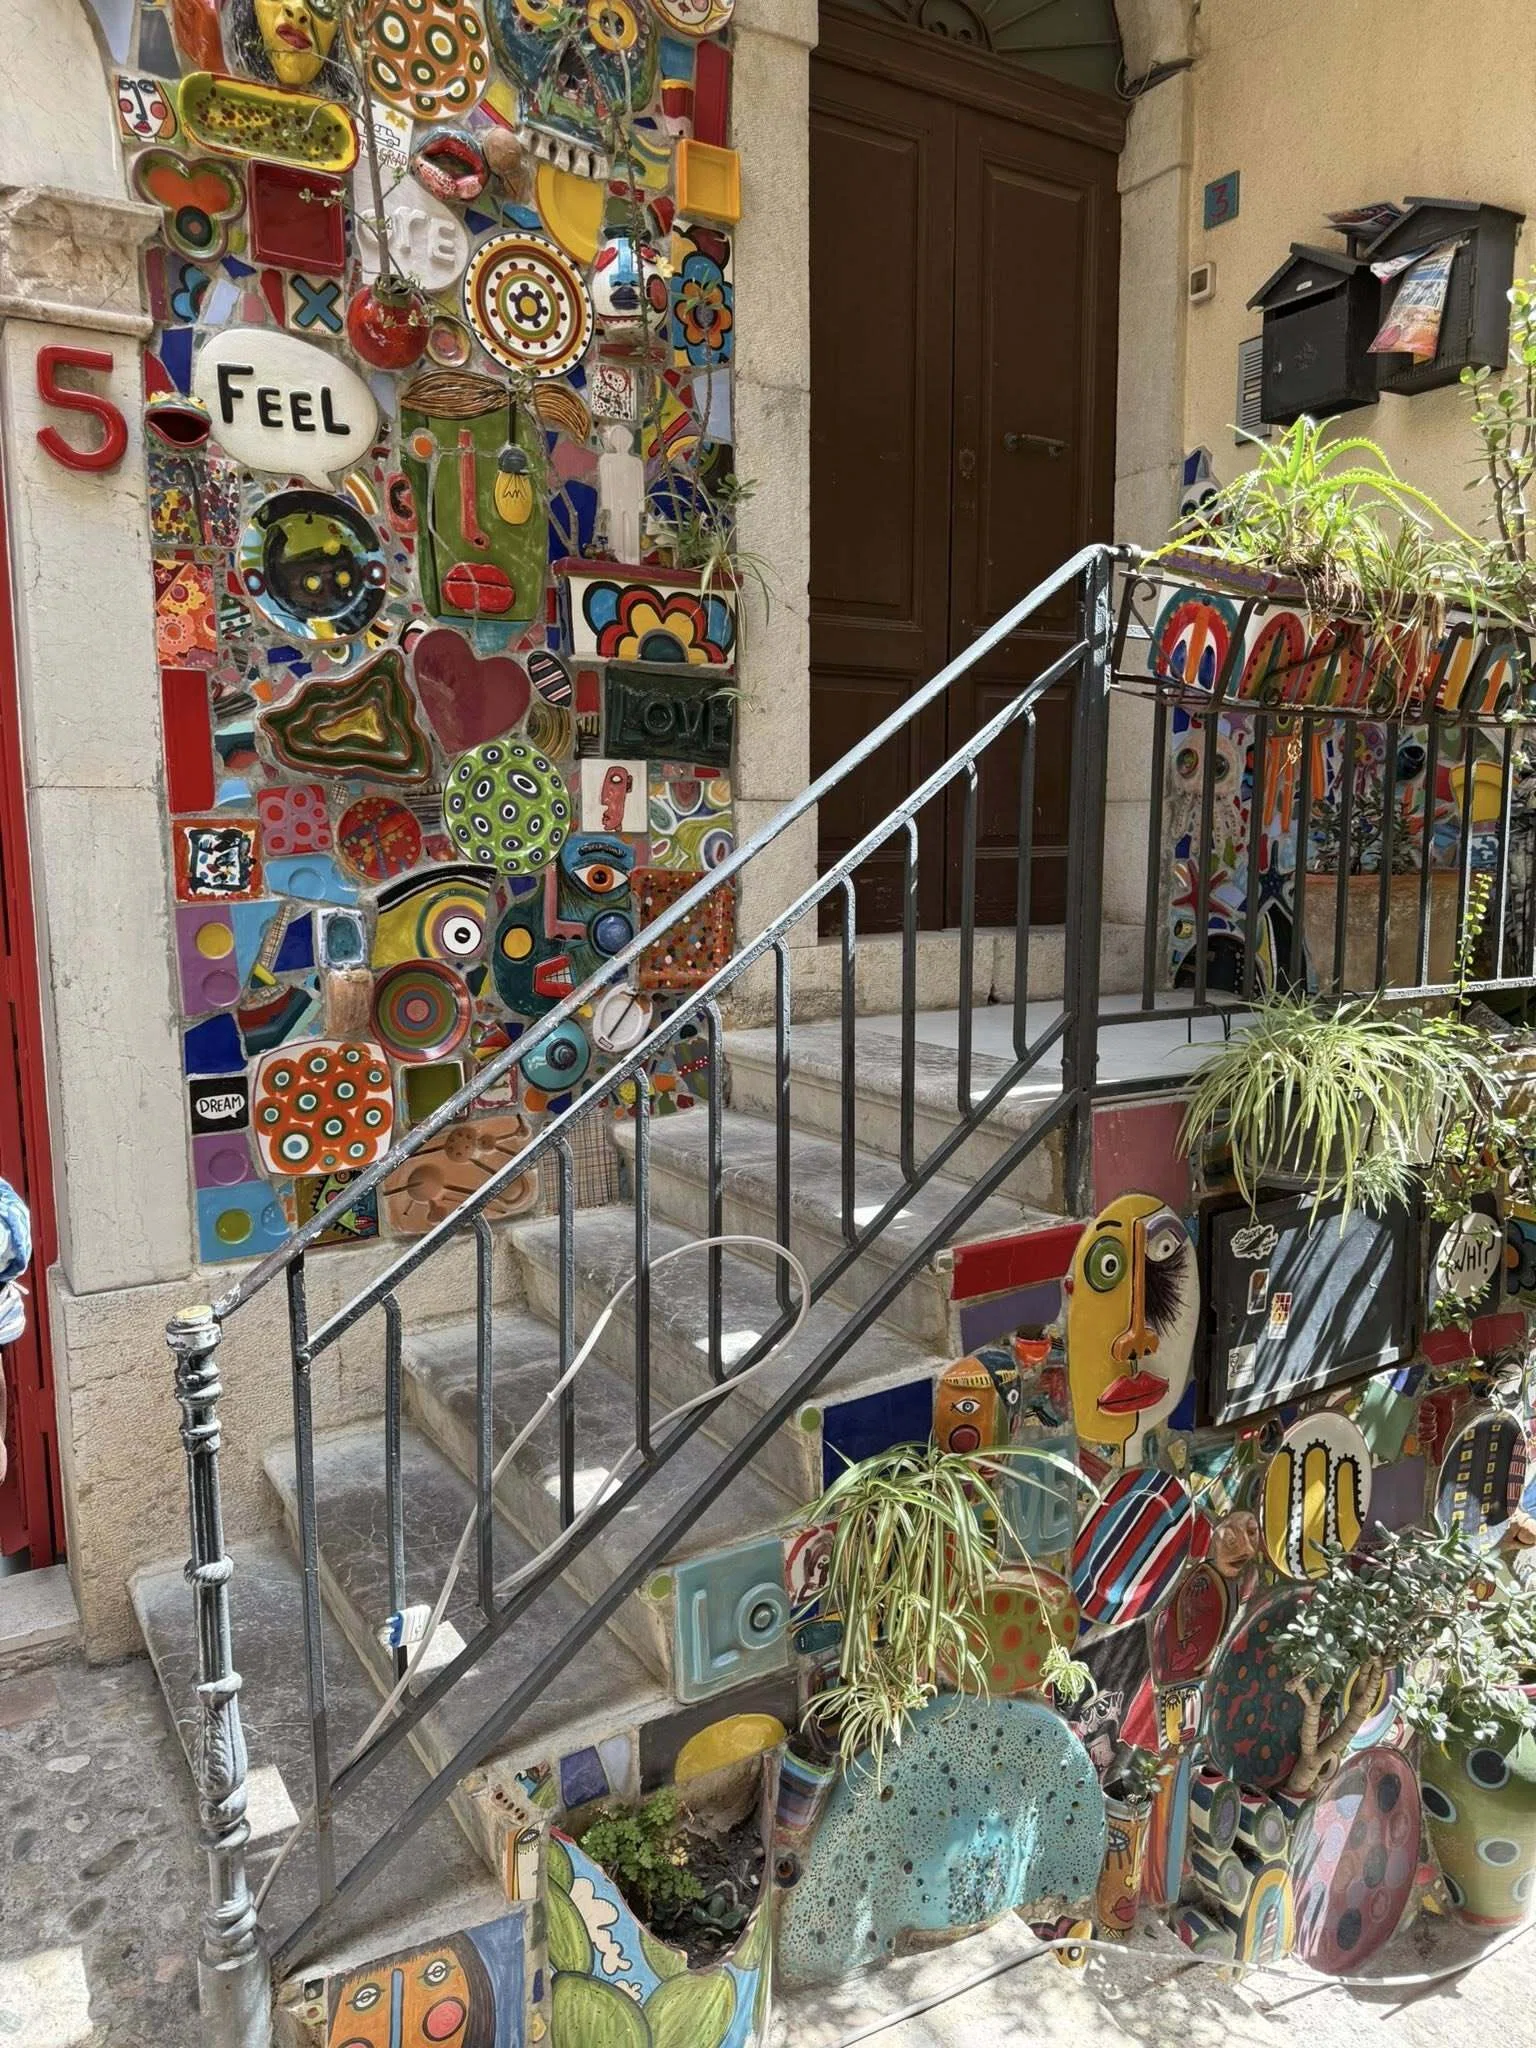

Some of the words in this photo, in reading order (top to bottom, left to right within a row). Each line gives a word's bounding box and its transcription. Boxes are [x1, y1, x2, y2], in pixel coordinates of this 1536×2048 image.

[1210, 182, 1232, 219] 3
[36, 343, 128, 472] 5
[217, 363, 351, 435] FEEL
[608, 684, 730, 750] LOVE
[199, 1095, 241, 1114] DREAM
